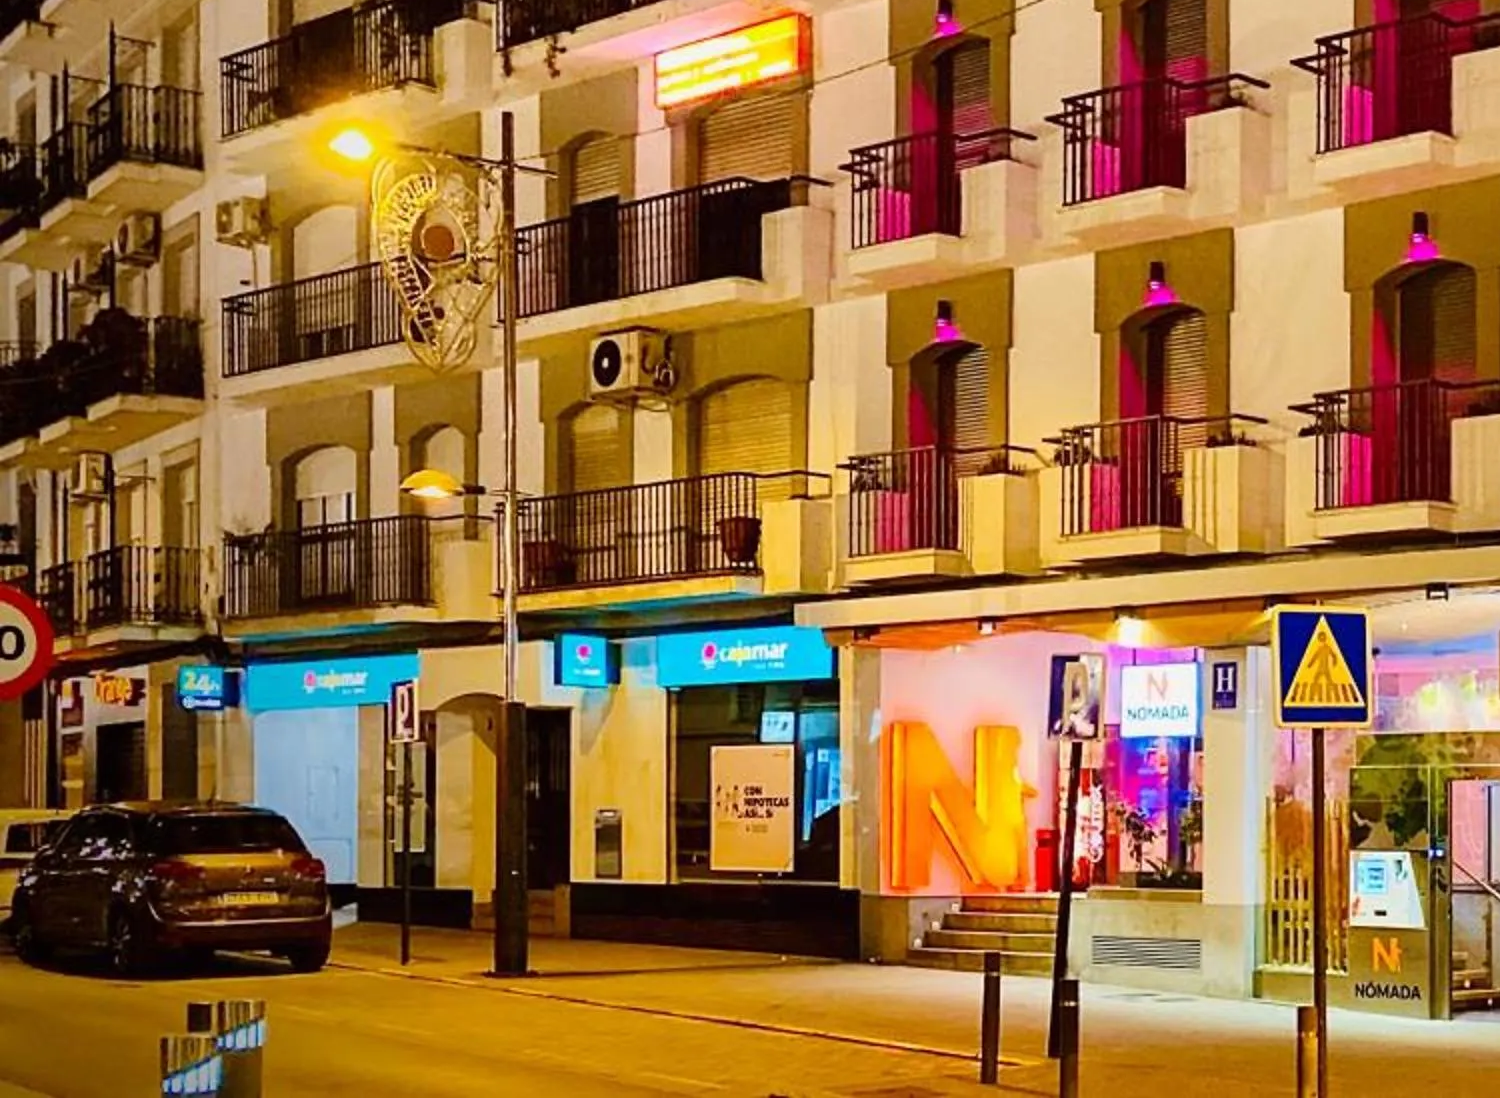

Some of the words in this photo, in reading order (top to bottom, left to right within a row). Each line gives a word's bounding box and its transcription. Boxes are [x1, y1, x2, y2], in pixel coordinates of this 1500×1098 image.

[1216, 667, 1234, 692] H
[743, 797, 790, 807] HIPOTECAS
[1354, 981, 1422, 1000] NÓMADA
